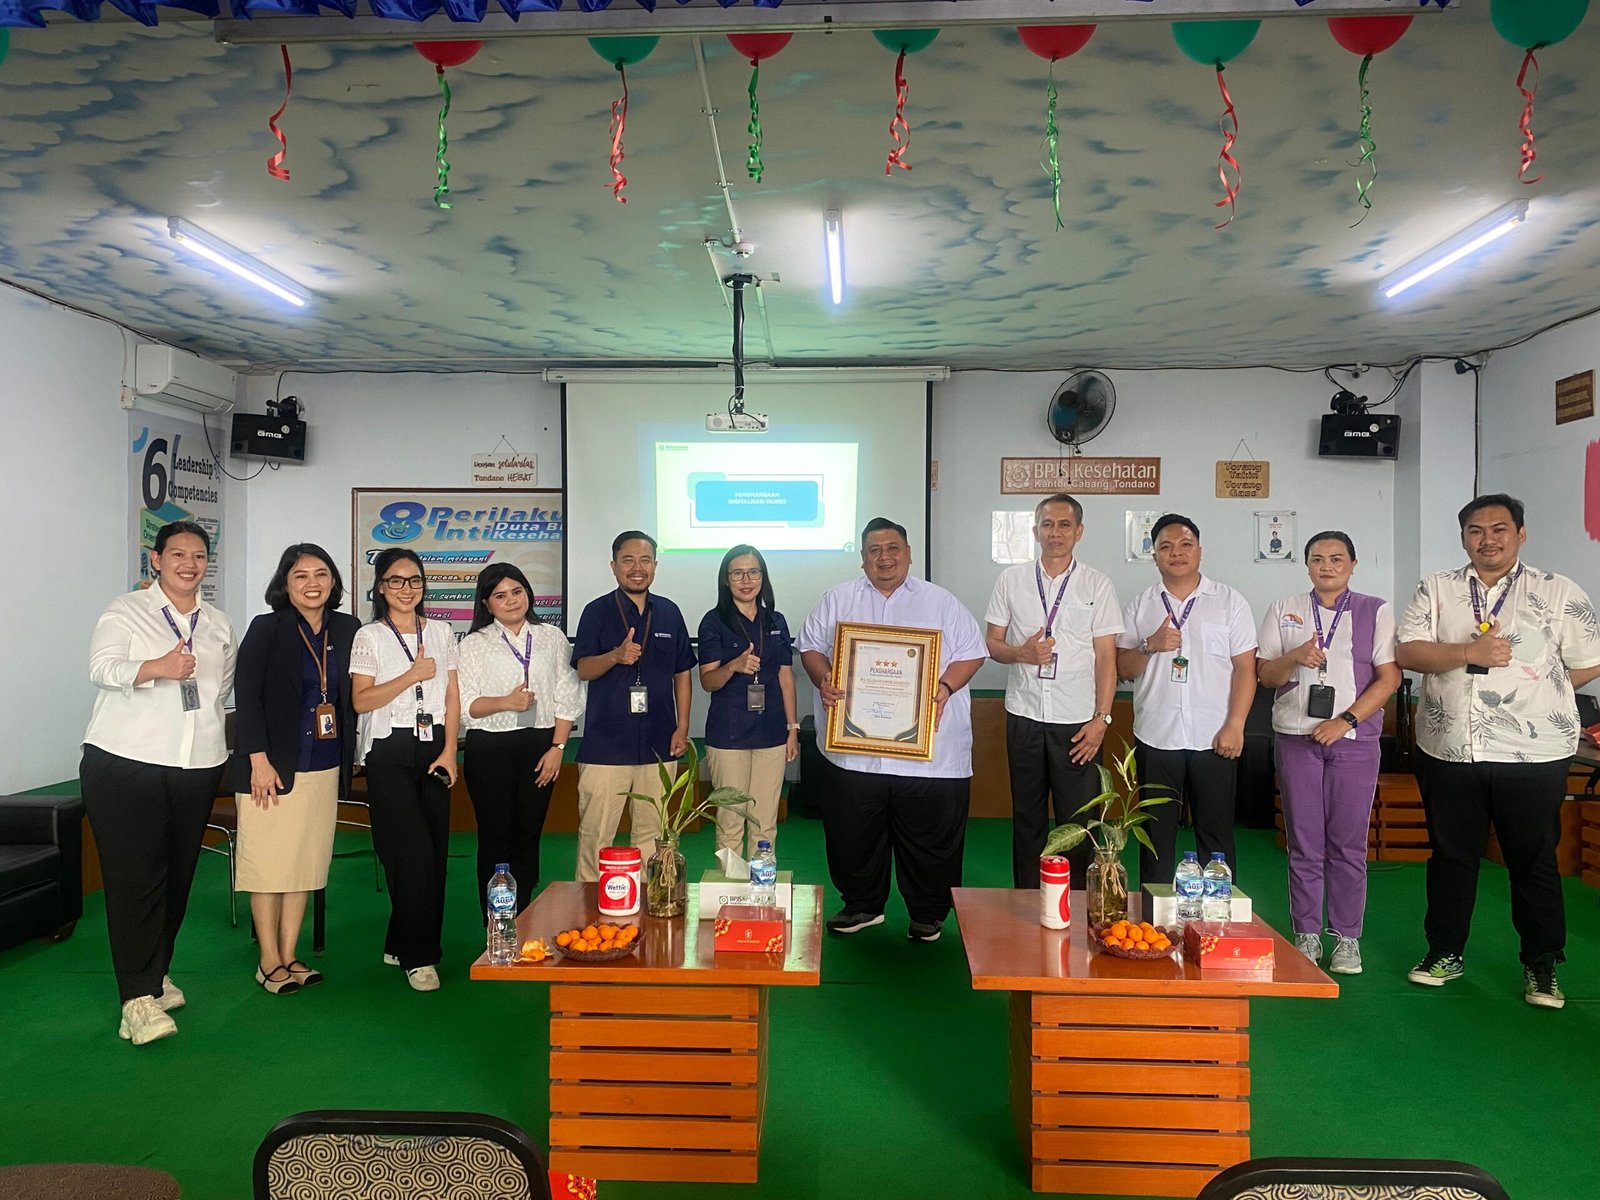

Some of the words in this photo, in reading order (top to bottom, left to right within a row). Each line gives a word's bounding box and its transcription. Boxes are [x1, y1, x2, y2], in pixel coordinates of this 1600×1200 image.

[142, 438, 168, 511] 6
[173, 453, 213, 480] Leadership
[1034, 462, 1069, 479] BPJS
[1074, 462, 1156, 479] Kesehatan
[168, 481, 218, 504] Competencies
[1034, 479, 1067, 489] Kantor
[1071, 479, 1109, 491] Cabang
[1113, 479, 1156, 489] Tondano
[371, 501, 427, 544] 8
[426, 507, 562, 526] Perilaku
[495, 522, 540, 531] Duta
[546, 522, 562, 531] B
[434, 520, 492, 541] Inti
[493, 530, 561, 540] Keseha
